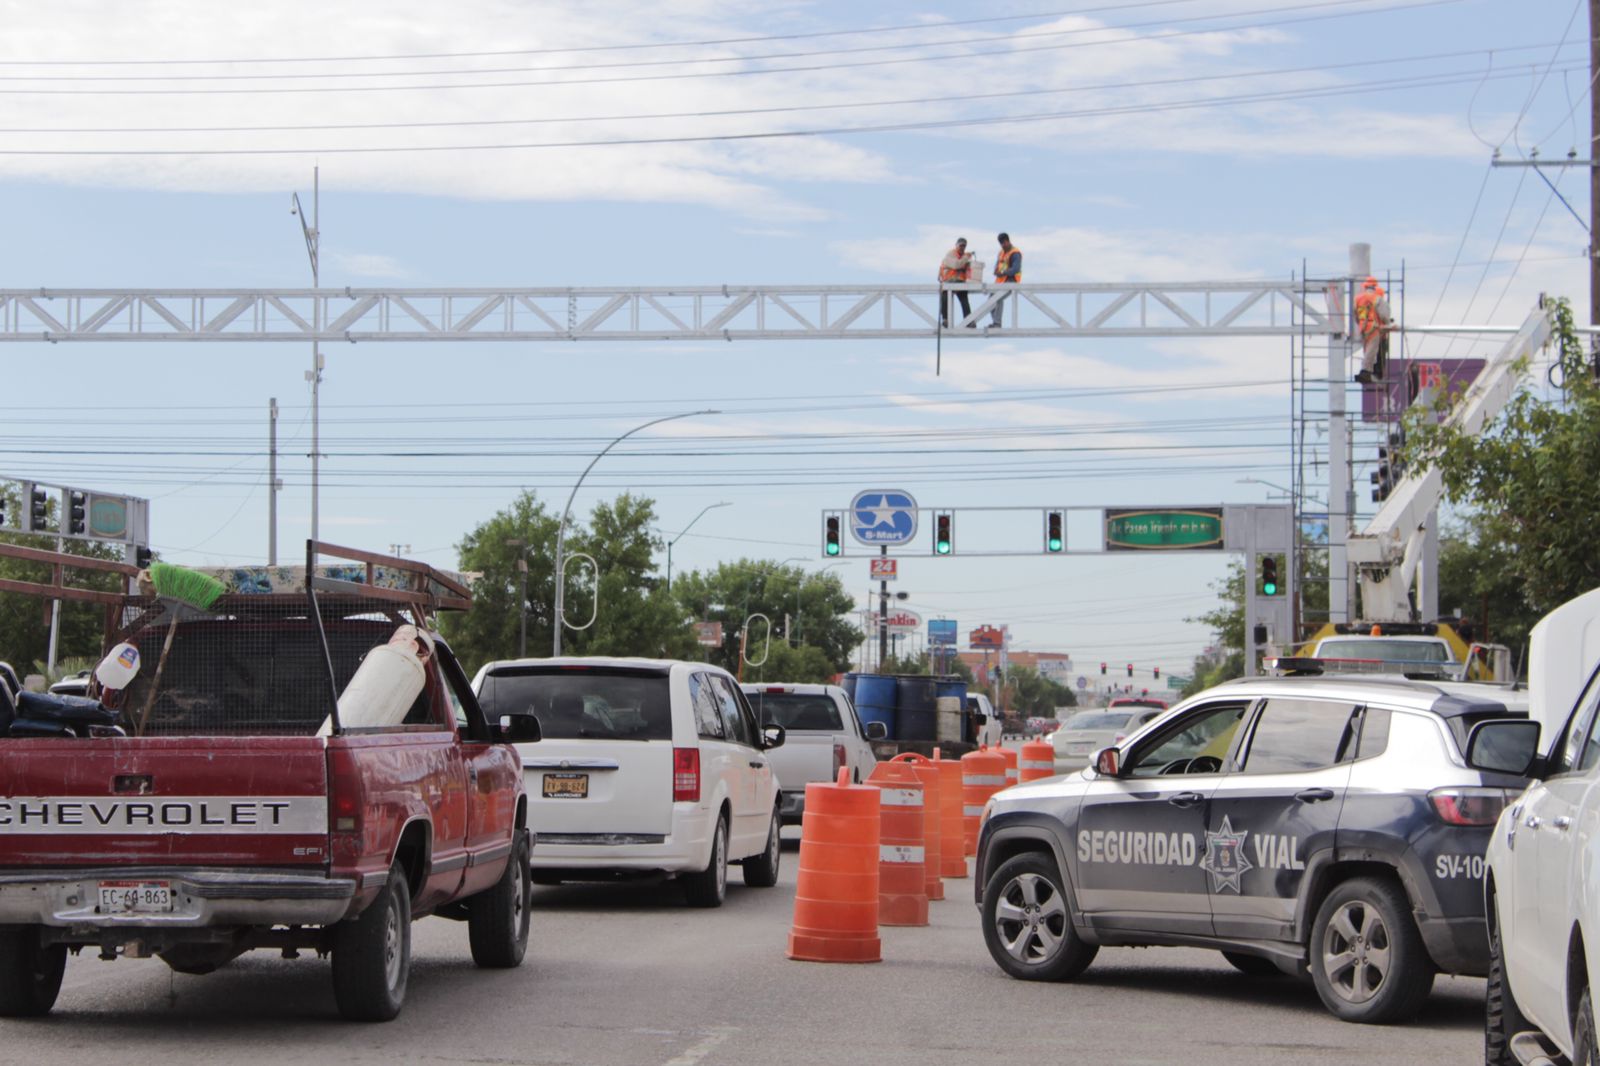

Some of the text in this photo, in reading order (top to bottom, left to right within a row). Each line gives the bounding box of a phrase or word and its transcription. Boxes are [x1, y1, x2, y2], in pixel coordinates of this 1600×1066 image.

[1124, 520, 1148, 534] Paseo
[865, 531, 903, 540] S-Mart
[873, 560, 893, 573] 24
[293, 847, 322, 856] EFI
[1077, 830, 1305, 870] SEGURIDAD VIAL
[1435, 854, 1486, 879] SV-10
